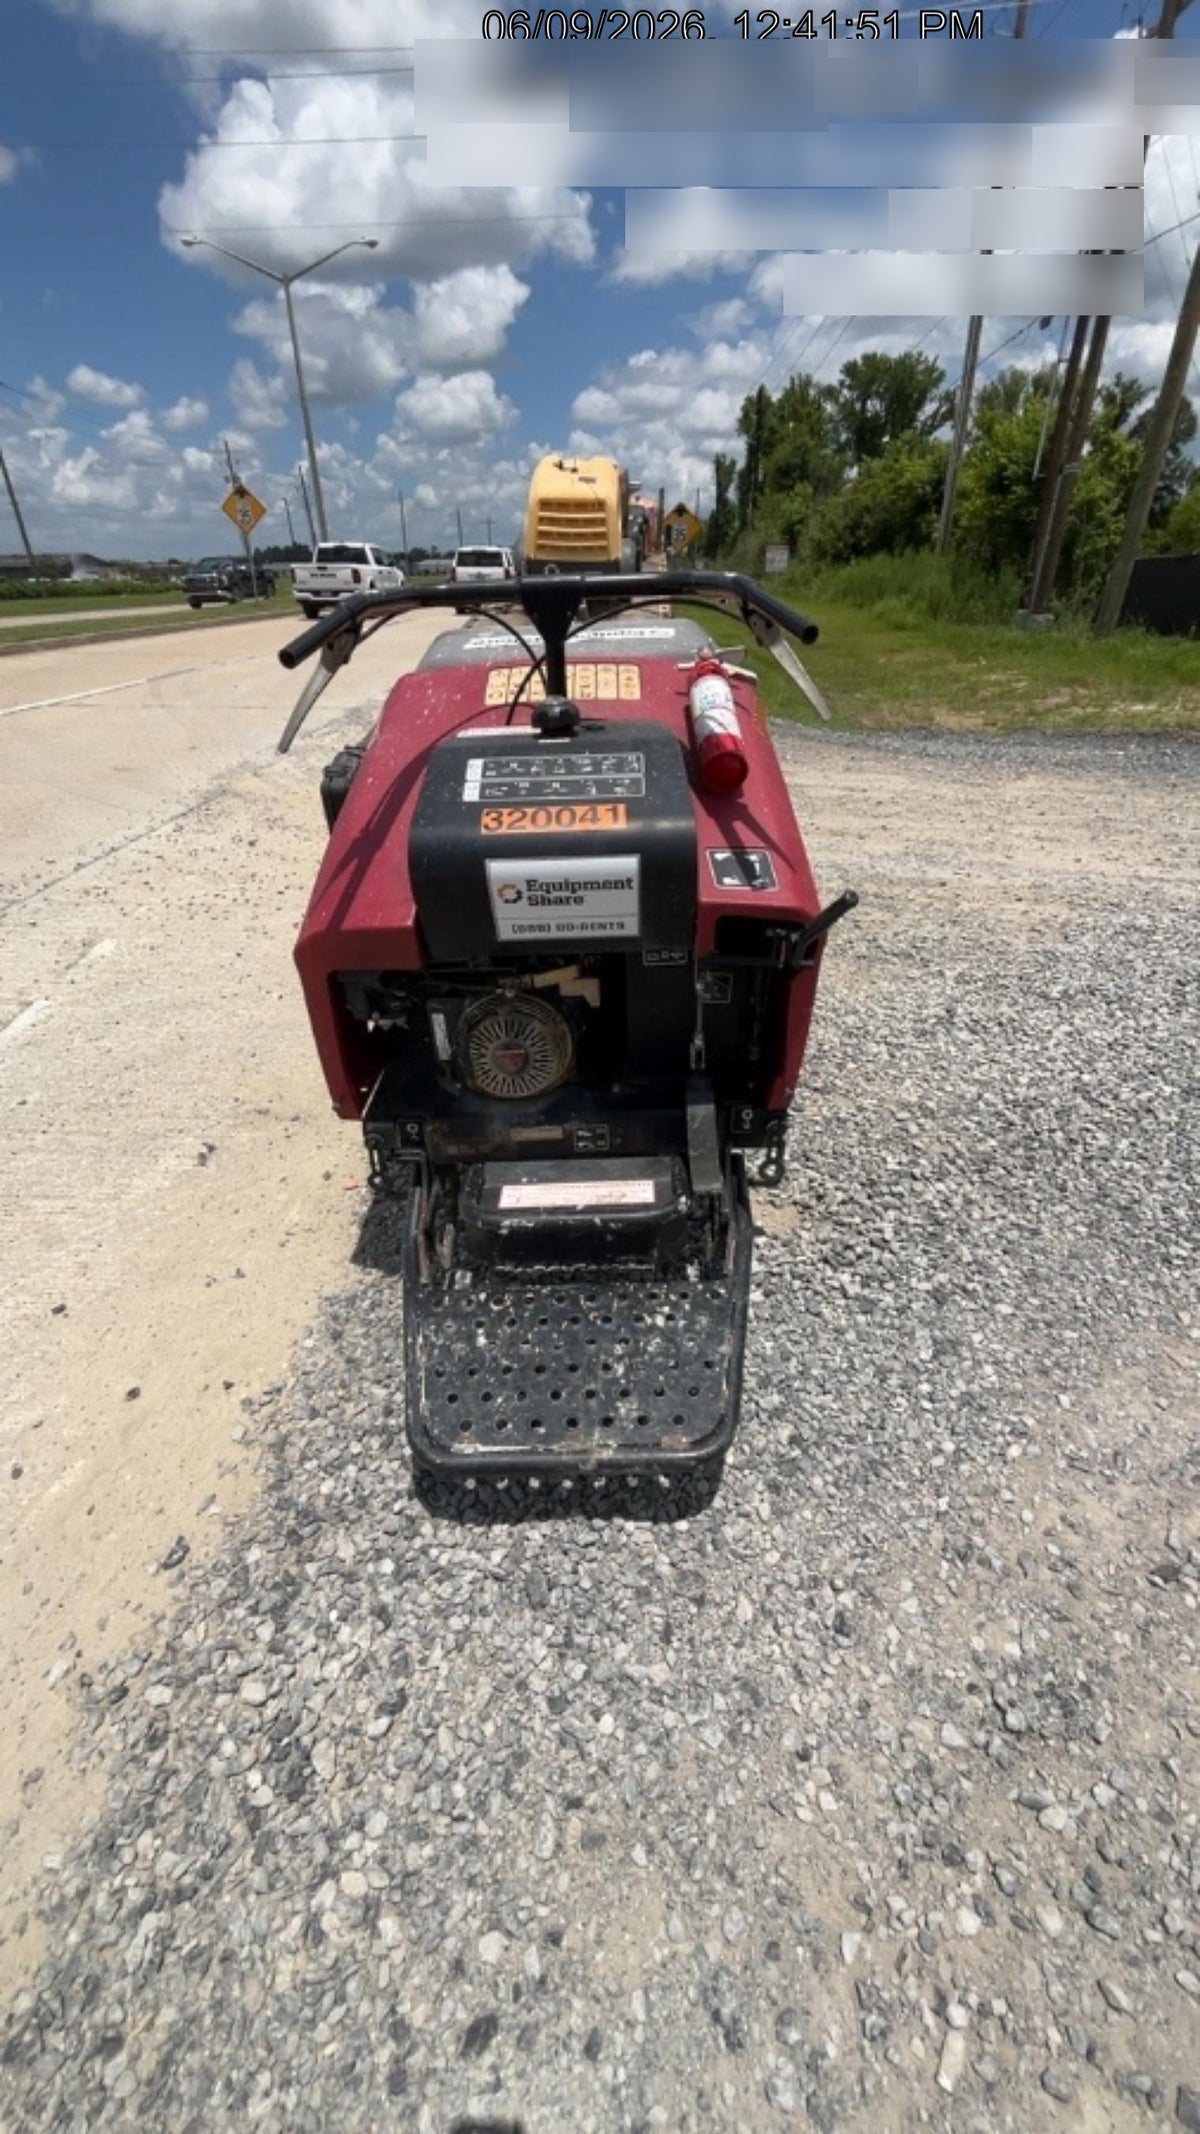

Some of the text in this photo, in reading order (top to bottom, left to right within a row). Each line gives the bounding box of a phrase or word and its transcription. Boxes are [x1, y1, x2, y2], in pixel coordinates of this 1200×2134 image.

[483, 806, 620, 832] 320041
[525, 877, 634, 894] Equipment
[527, 894, 585, 907] Share
